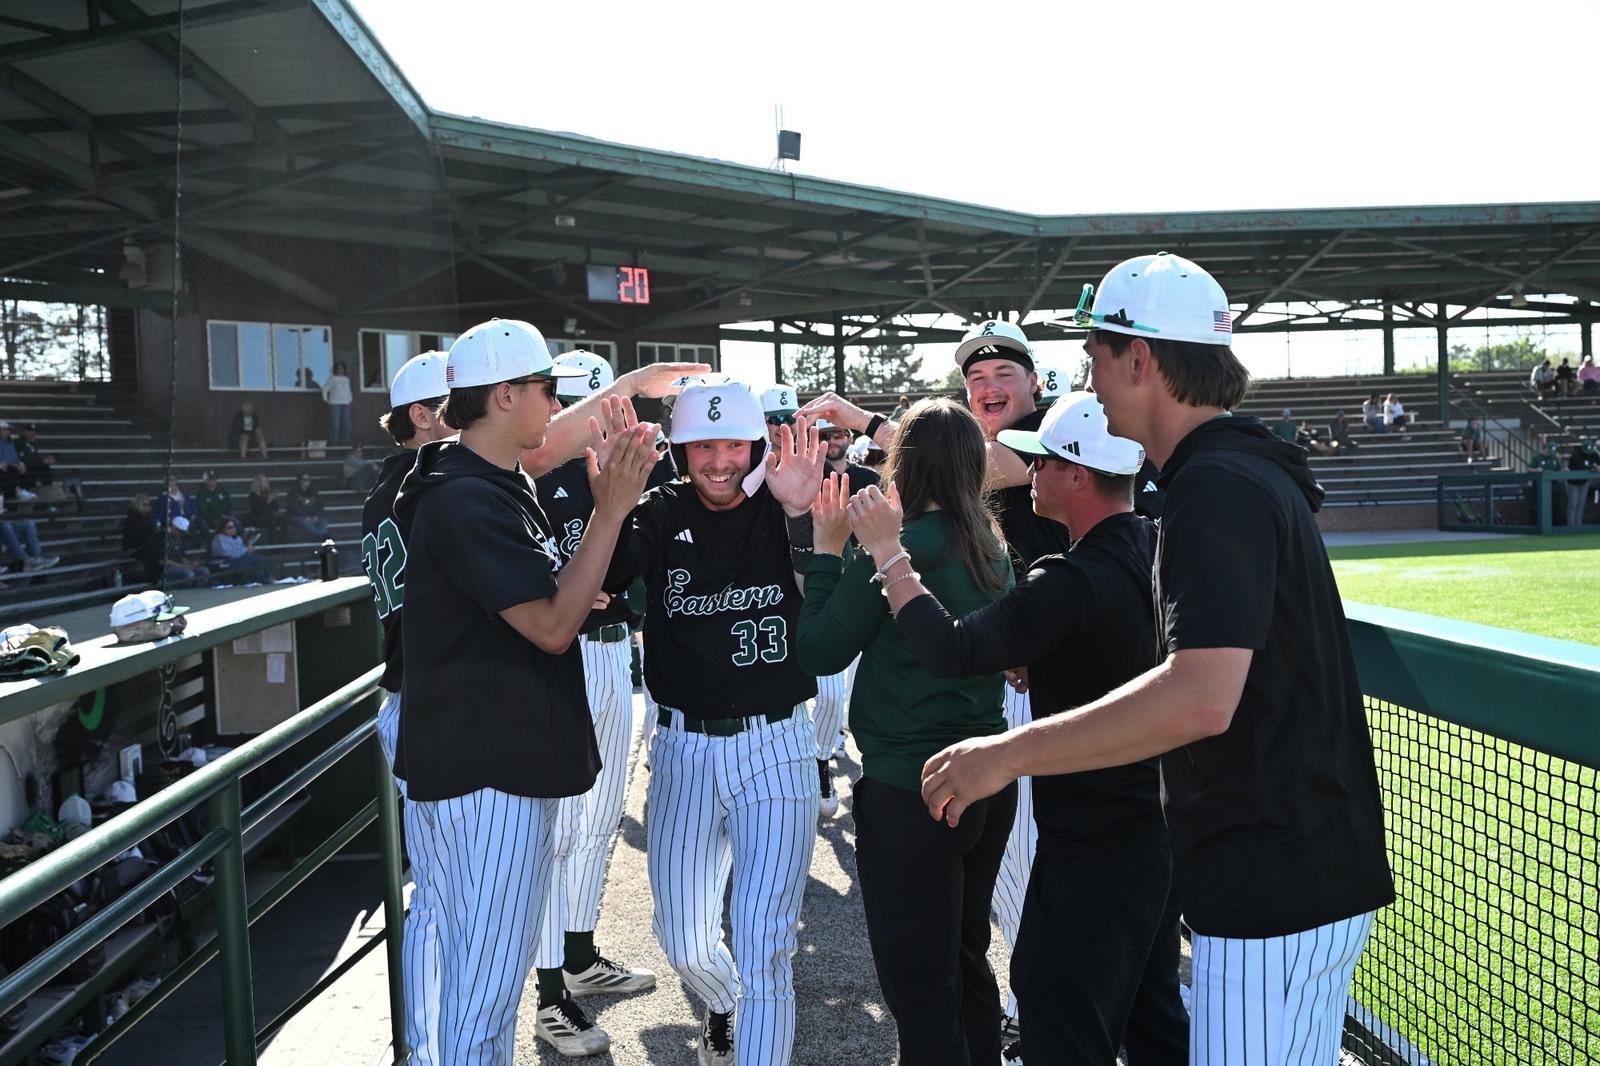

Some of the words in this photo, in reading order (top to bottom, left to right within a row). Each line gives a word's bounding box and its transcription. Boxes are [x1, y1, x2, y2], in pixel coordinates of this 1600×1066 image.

[620, 266, 650, 304] 20
[589, 367, 601, 390] E
[1046, 370, 1058, 392] E
[708, 396, 722, 422] E
[361, 517, 408, 620] 32
[663, 568, 784, 618] Eastern
[731, 615, 788, 667] 33
